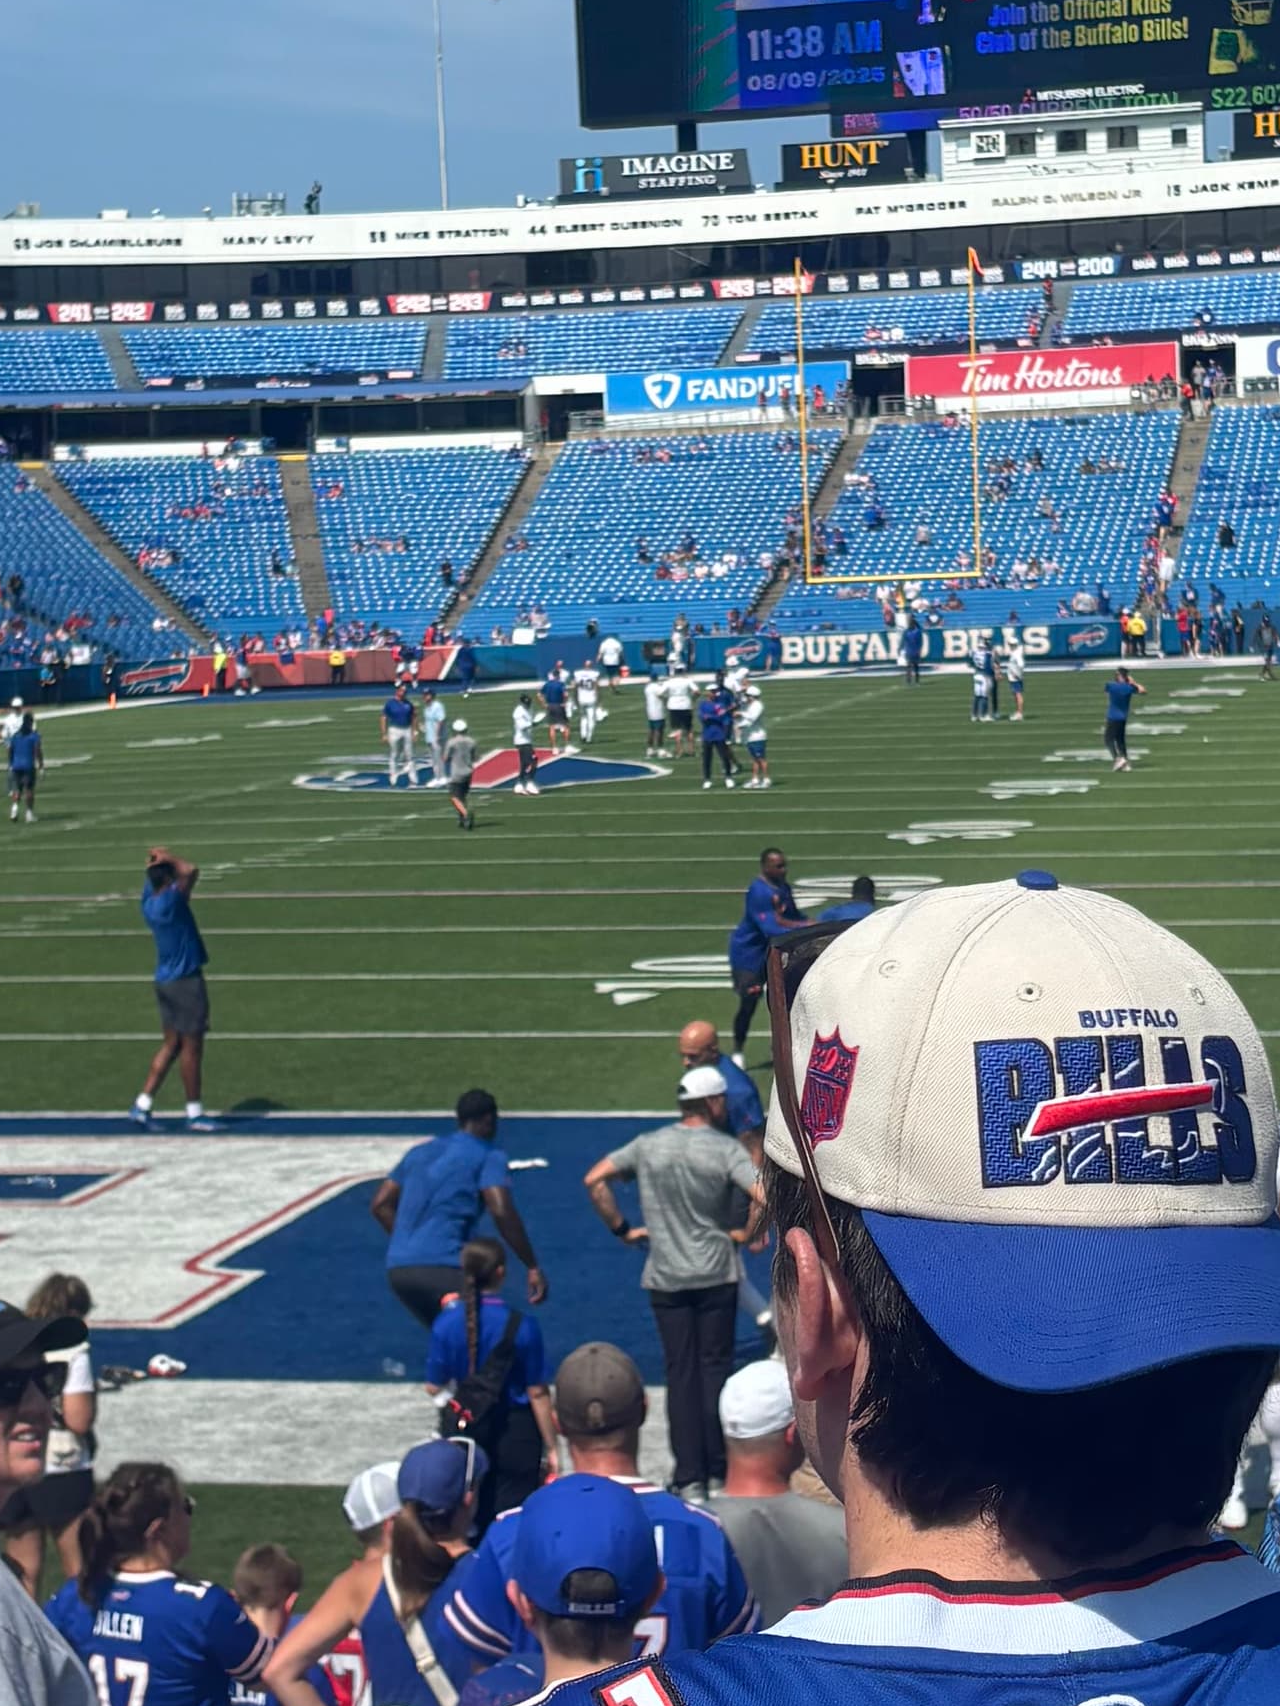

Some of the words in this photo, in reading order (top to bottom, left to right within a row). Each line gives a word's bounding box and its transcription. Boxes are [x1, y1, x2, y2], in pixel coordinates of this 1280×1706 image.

[988, 4, 1026, 28] Join
[1030, 1, 1060, 23] the
[747, 25, 825, 61] 11:38
[832, 20, 883, 56] AM
[976, 31, 1016, 54] Club
[1020, 29, 1038, 51] of
[1042, 28, 1071, 50] the
[1074, 22, 1139, 47] Buffalo
[1143, 16, 1189, 43] Bills!
[747, 67, 887, 91] 08/09/2025
[621, 153, 735, 177] IMAGINE
[800, 141, 880, 170] HUNT
[638, 174, 717, 190] STAFFING
[1189, 182, 1231, 194] JACK
[727, 214, 757, 225] TOM
[1022, 259, 1057, 280] 244
[1078, 256, 1115, 276] 200
[958, 358, 1010, 393] Tim
[1014, 355, 1123, 389] Hortons
[1078, 1009, 1179, 1029] BUFFALO
[974, 1034, 1257, 1189] BILLS
